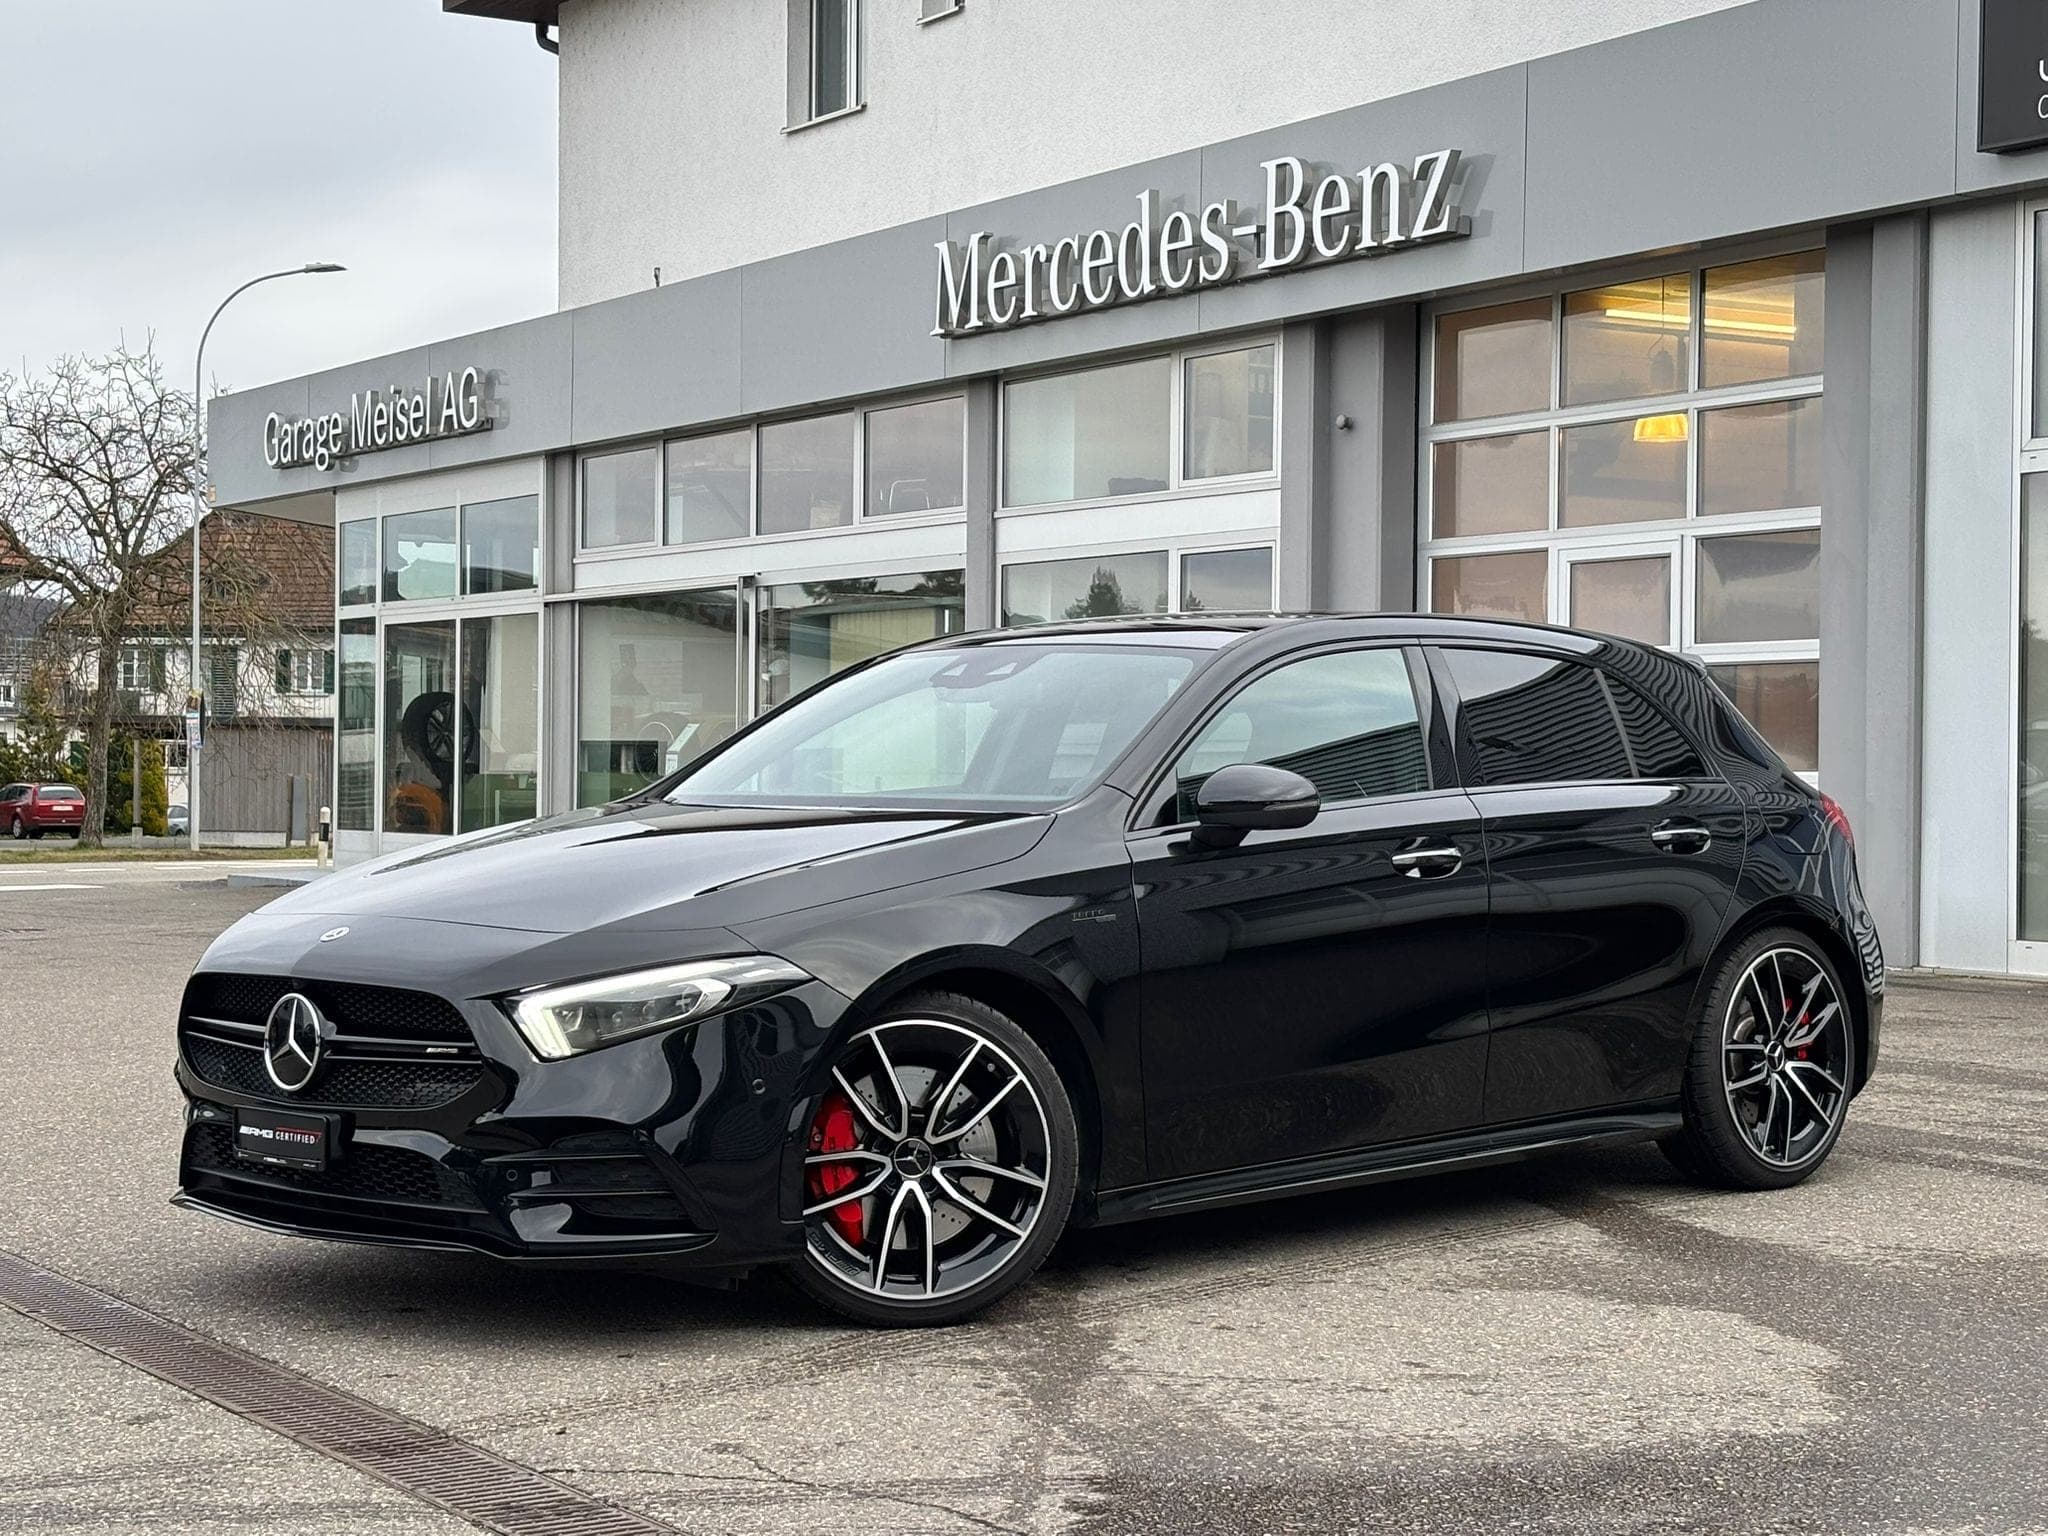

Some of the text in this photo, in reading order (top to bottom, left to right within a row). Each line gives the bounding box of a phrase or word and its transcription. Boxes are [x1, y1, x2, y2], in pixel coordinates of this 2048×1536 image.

[930, 149, 1460, 338] Mercedes-Benz
[264, 366, 479, 471] Garage Meisel AG
[244, 1126, 316, 1144] AMG CERTIFIED
